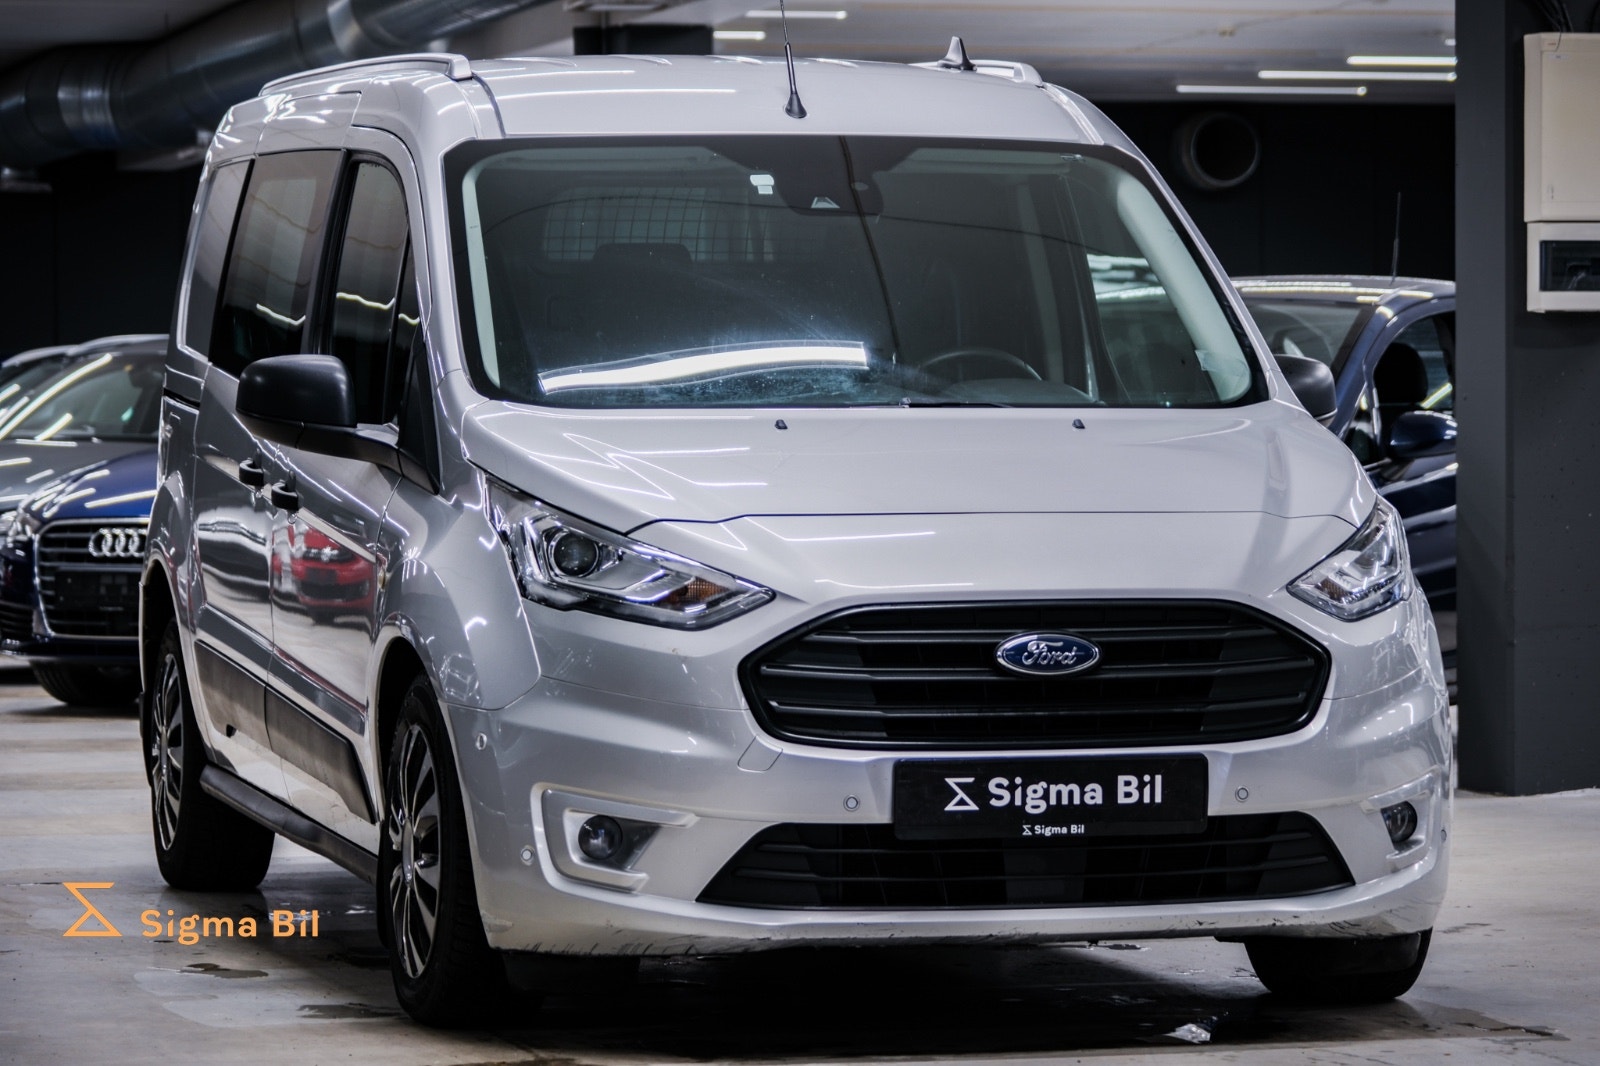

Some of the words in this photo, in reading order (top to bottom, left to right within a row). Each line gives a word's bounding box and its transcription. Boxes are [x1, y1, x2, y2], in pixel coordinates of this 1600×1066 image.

[1022, 641, 1077, 665] Ford
[988, 776, 1103, 814] Sigma
[1117, 774, 1162, 804] Bil
[1034, 825, 1068, 836] Sigma
[1070, 824, 1085, 834] Bil
